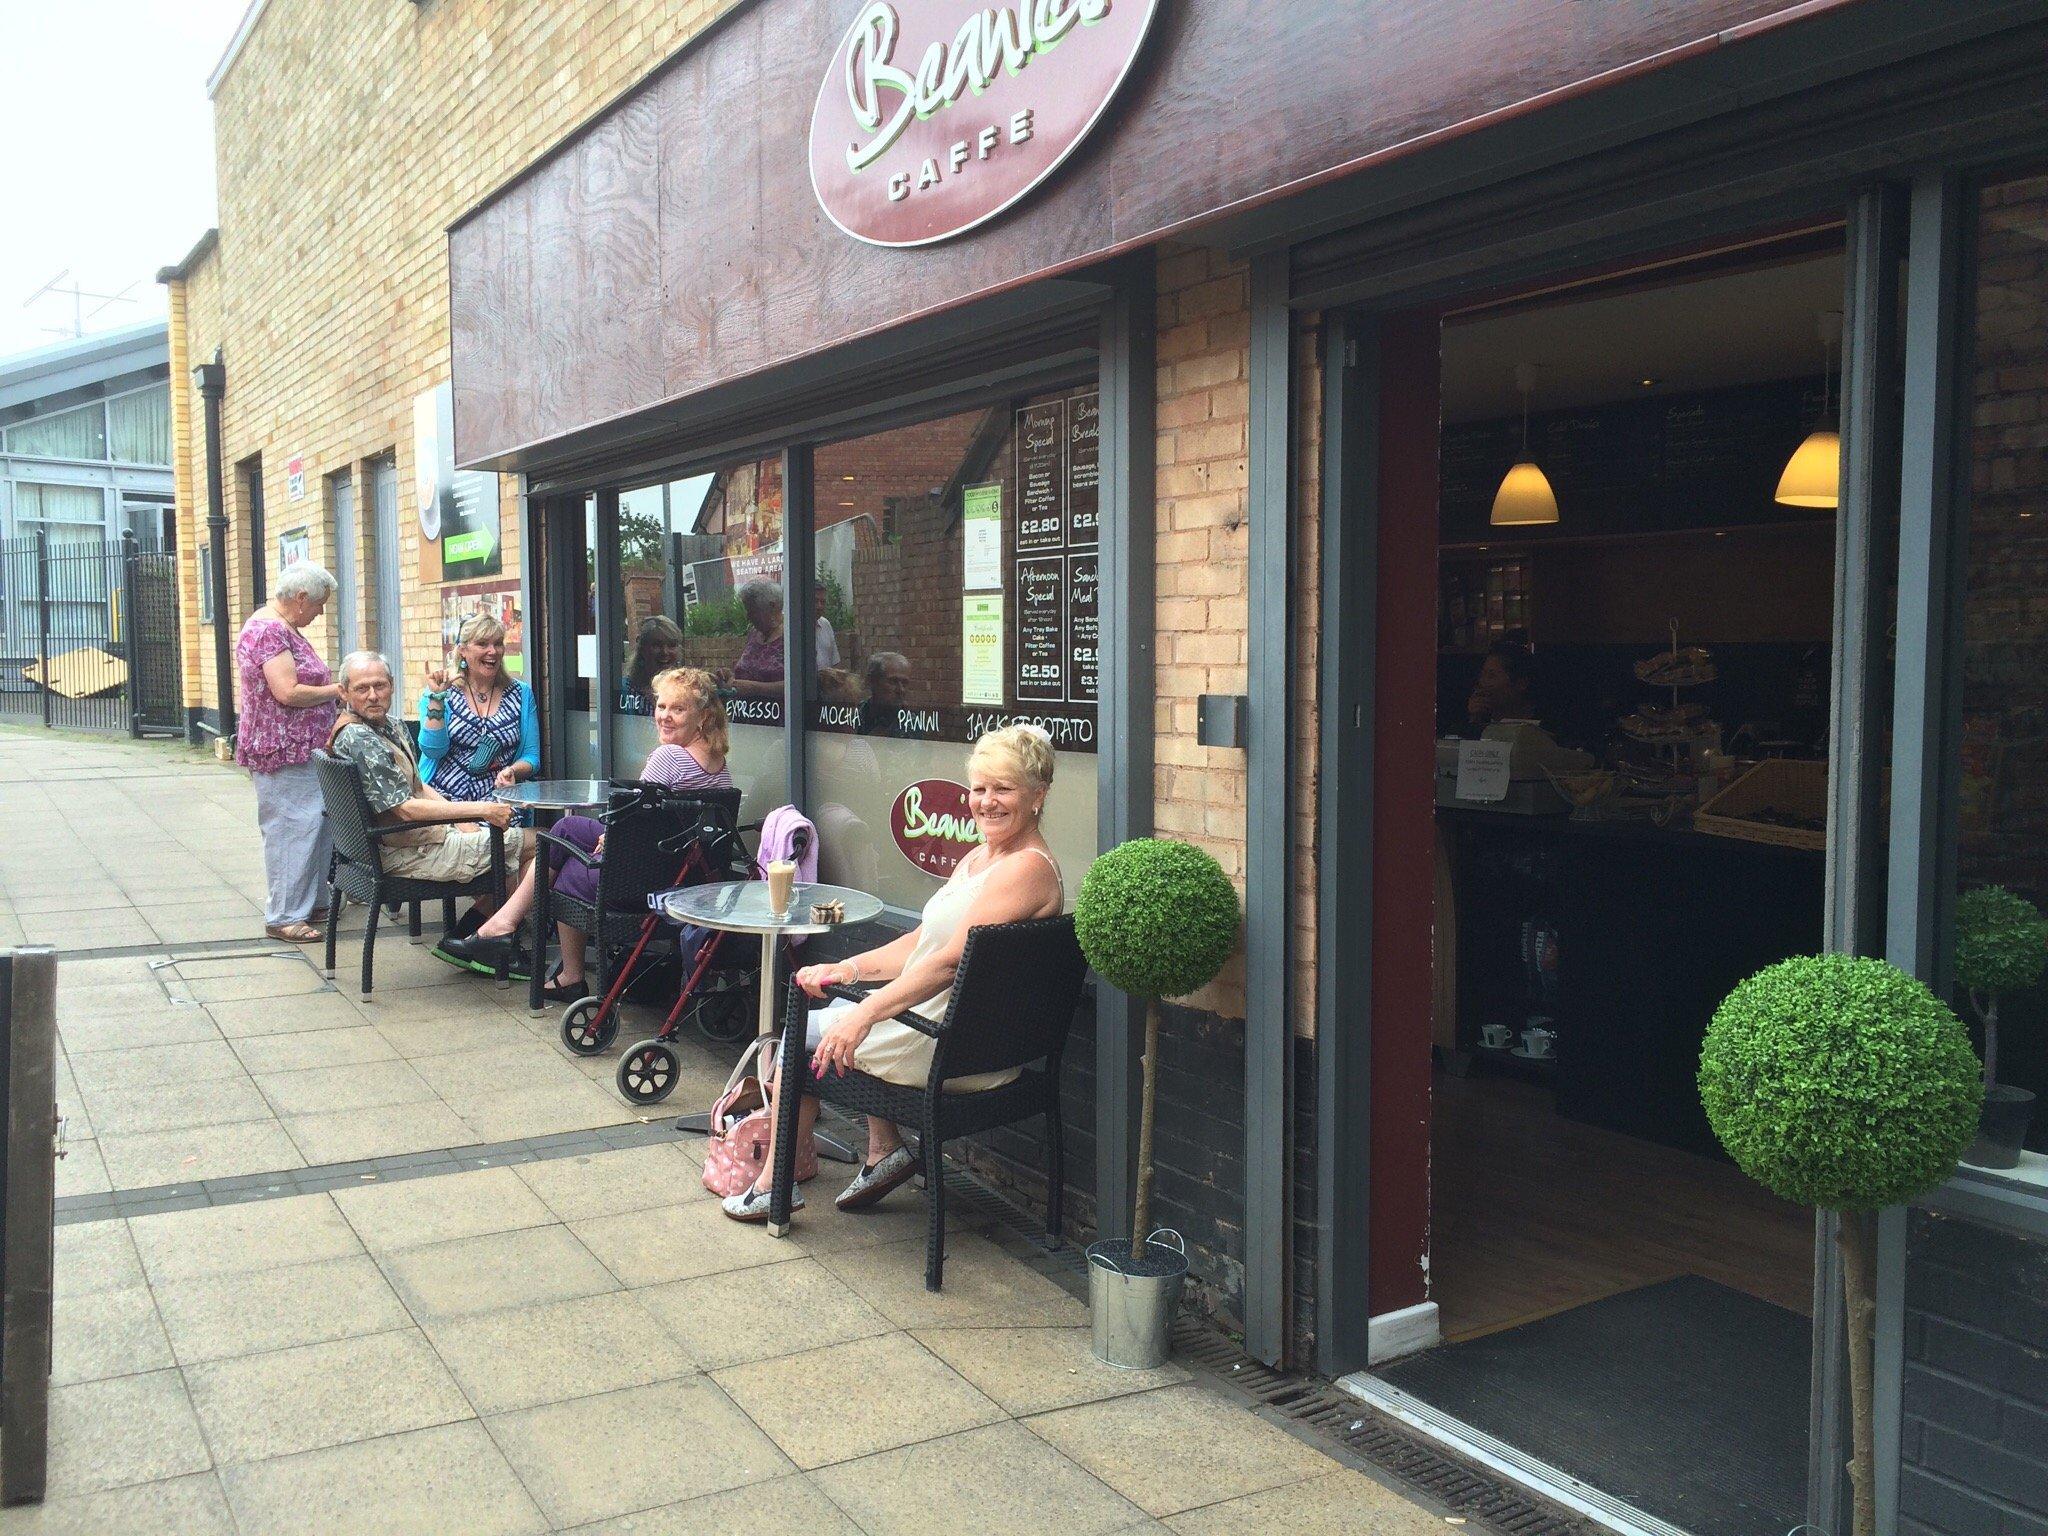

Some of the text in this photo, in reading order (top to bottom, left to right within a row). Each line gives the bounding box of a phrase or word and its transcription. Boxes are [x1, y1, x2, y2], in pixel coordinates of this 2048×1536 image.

[886, 108, 1035, 202] CAFFE
[1025, 430, 1054, 453] Special
[1022, 517, 1060, 534] £2.80
[736, 564, 783, 576] SEATING AREA
[742, 558, 758, 567] HAVE
[1020, 566, 1060, 585] Afternoon
[1026, 585, 1054, 606] Special
[1070, 586, 1092, 604] Meal
[1021, 664, 1060, 678] £2.50
[726, 698, 780, 720] EXPRESSO
[818, 705, 862, 729] MOCHA
[897, 706, 940, 732] PANINI
[918, 852, 958, 868] CAFF
